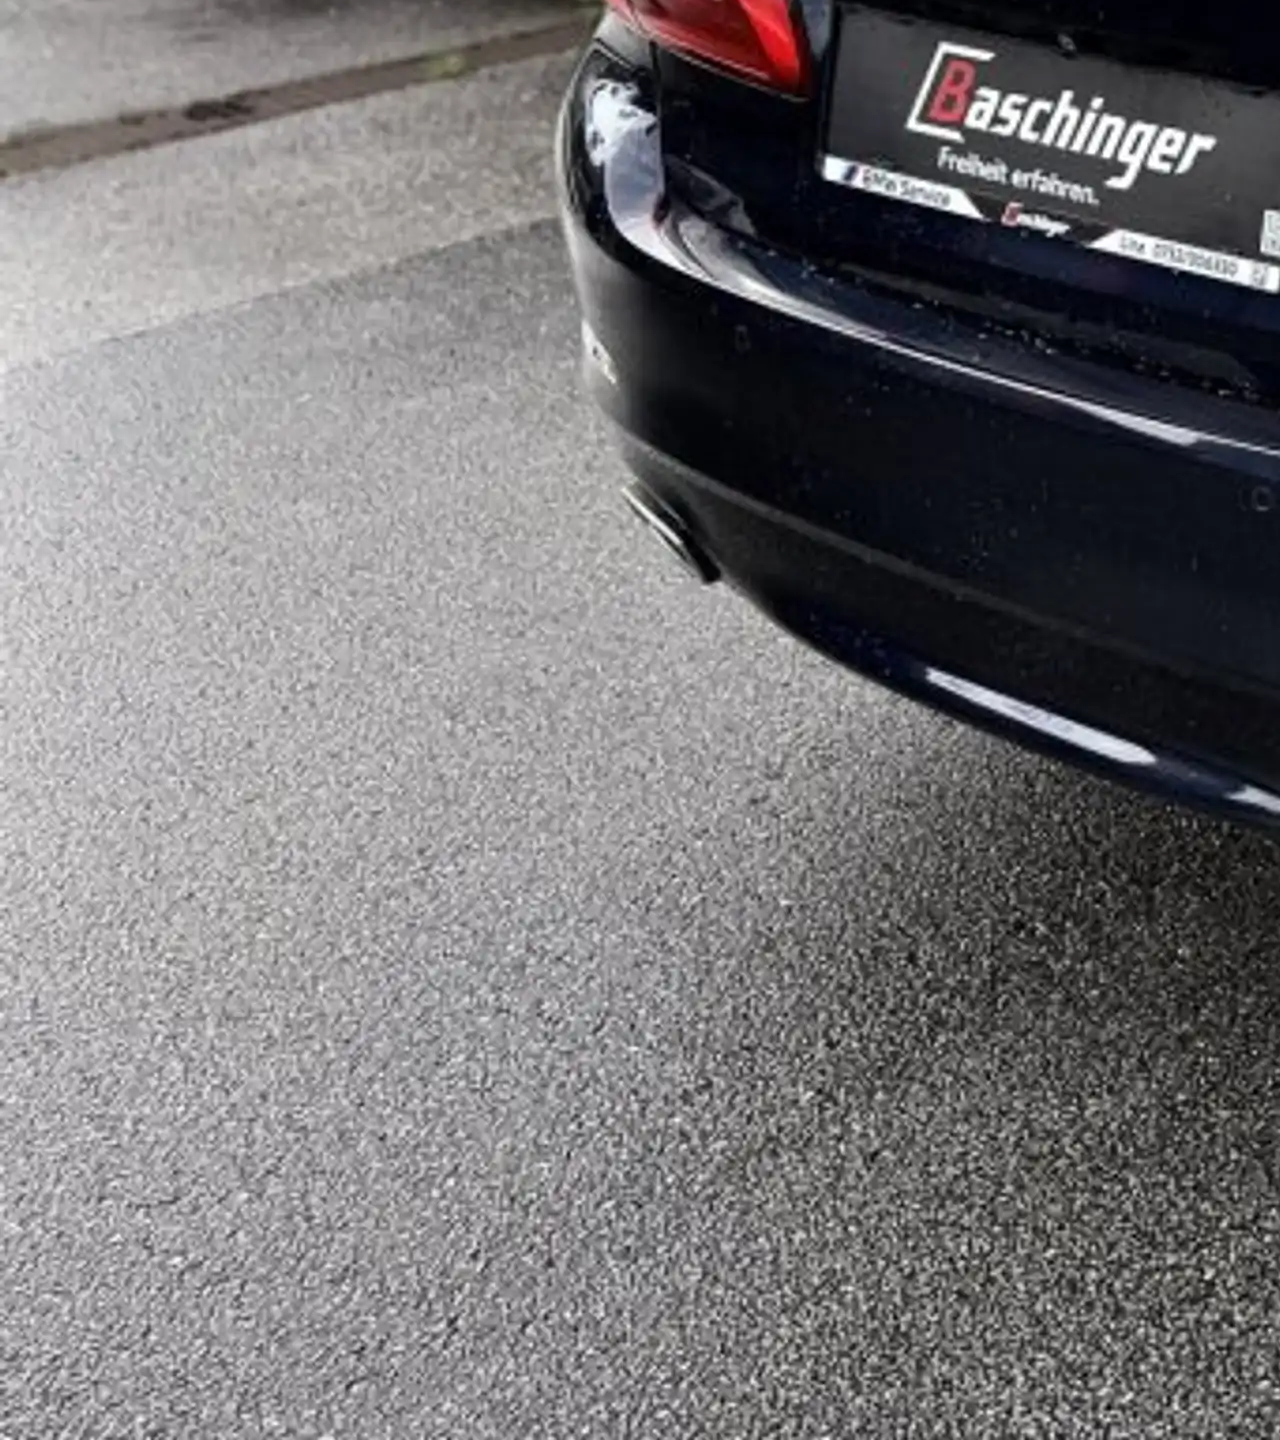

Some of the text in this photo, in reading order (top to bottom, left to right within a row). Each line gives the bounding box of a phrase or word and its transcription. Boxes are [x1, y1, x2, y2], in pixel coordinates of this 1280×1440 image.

[927, 58, 1217, 190] Baschinger
[937, 146, 1100, 206] Freiheit erfahren.
